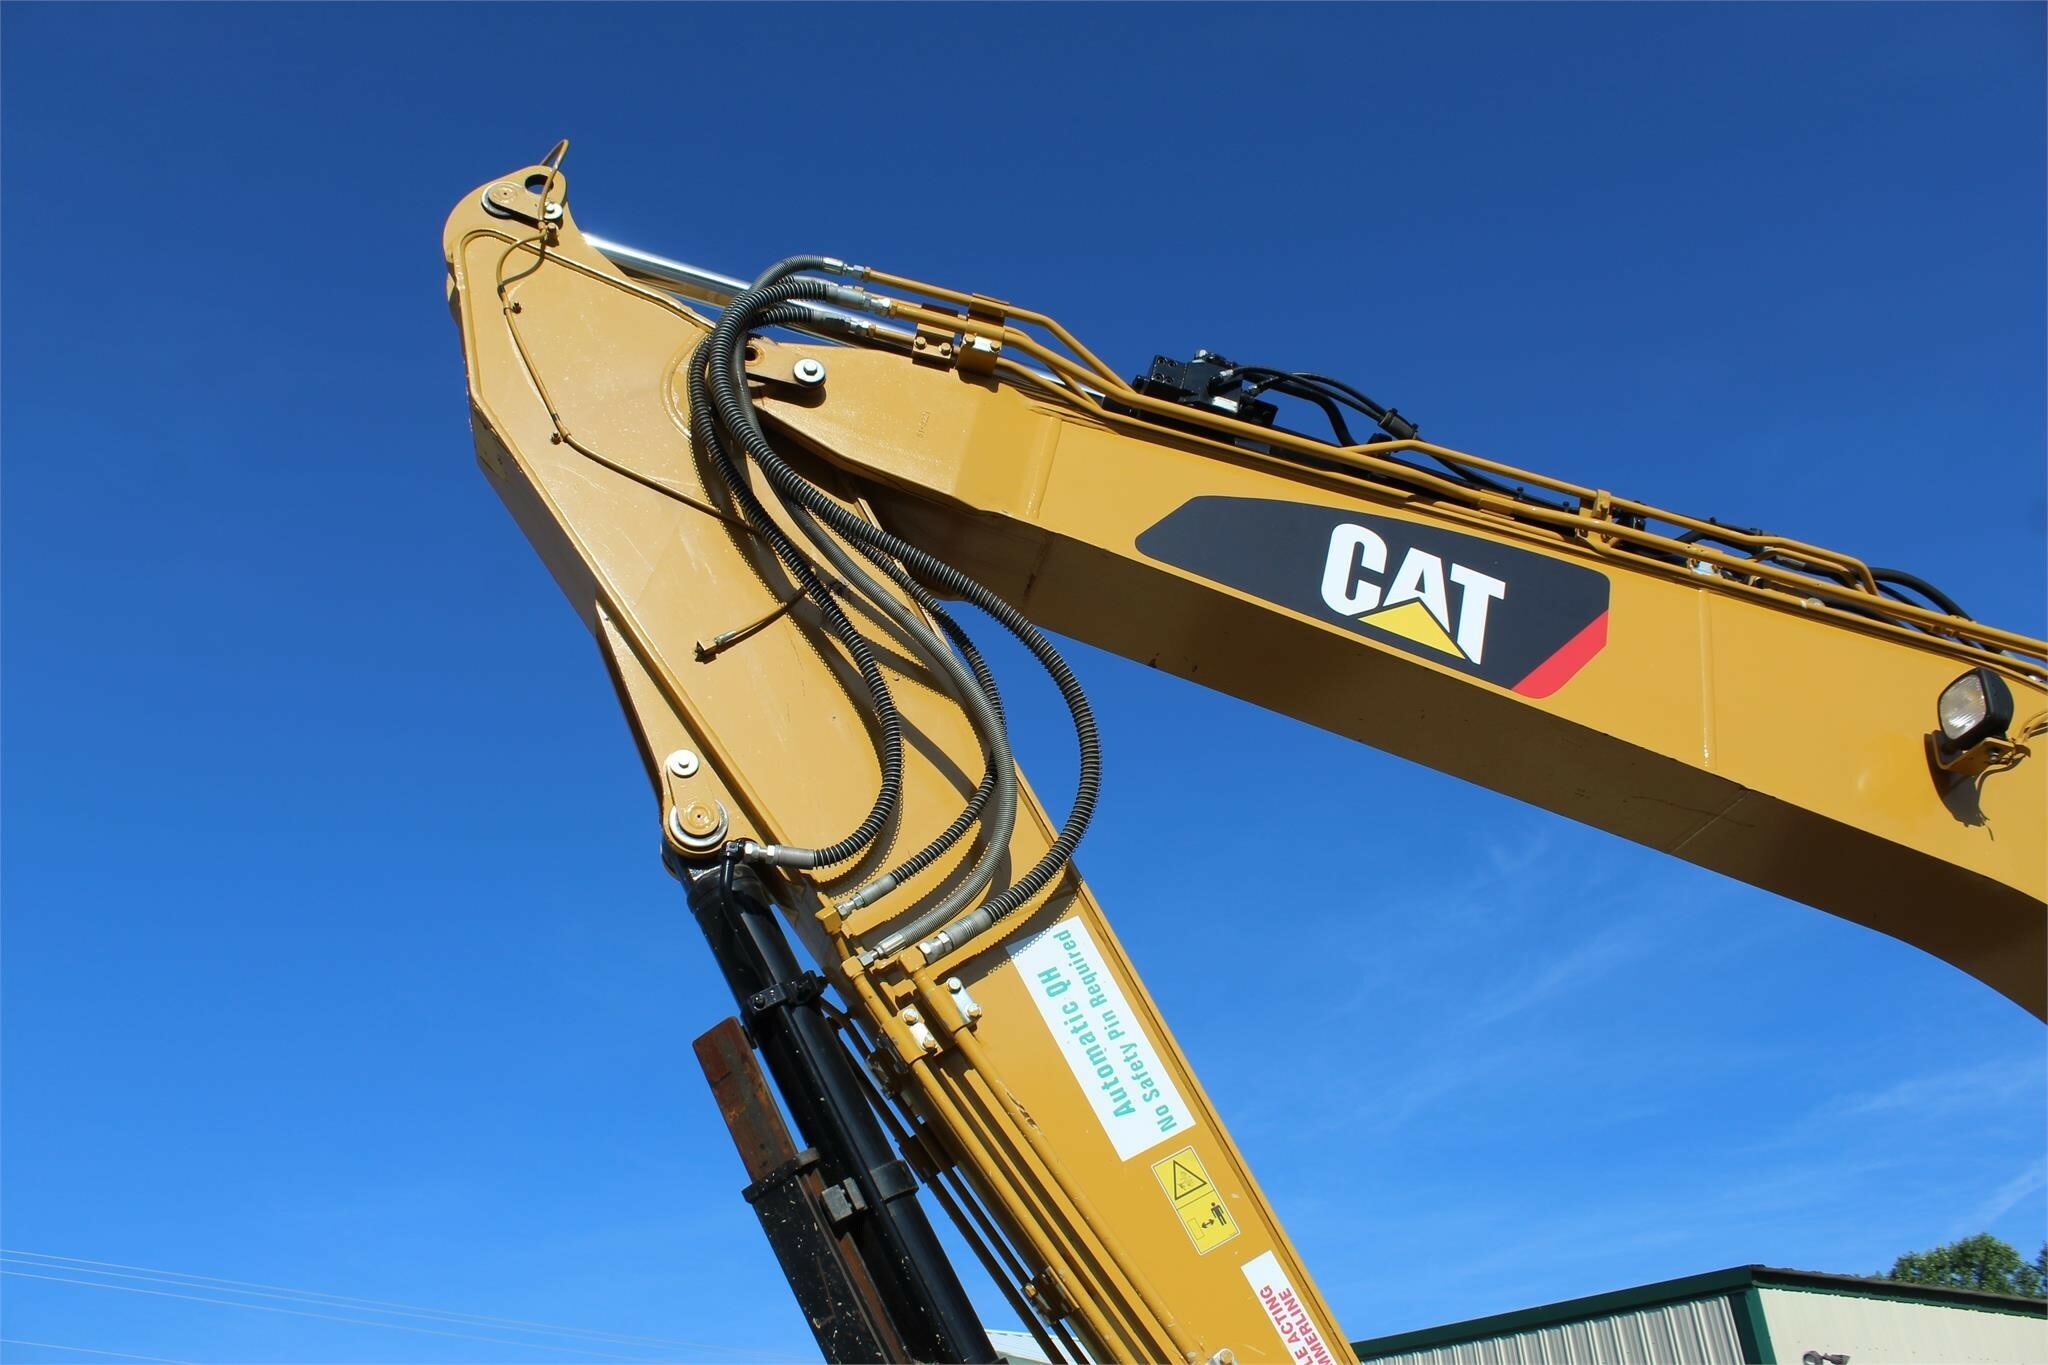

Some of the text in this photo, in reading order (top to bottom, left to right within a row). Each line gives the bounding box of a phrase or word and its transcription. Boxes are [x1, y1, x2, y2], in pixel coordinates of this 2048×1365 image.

[1321, 523, 1506, 665] CAT
[1037, 966, 1137, 1118] Automatic QH
[1053, 929, 1178, 1133] No Safety Pin Required
[1260, 1285, 1301, 1344] ACTING
